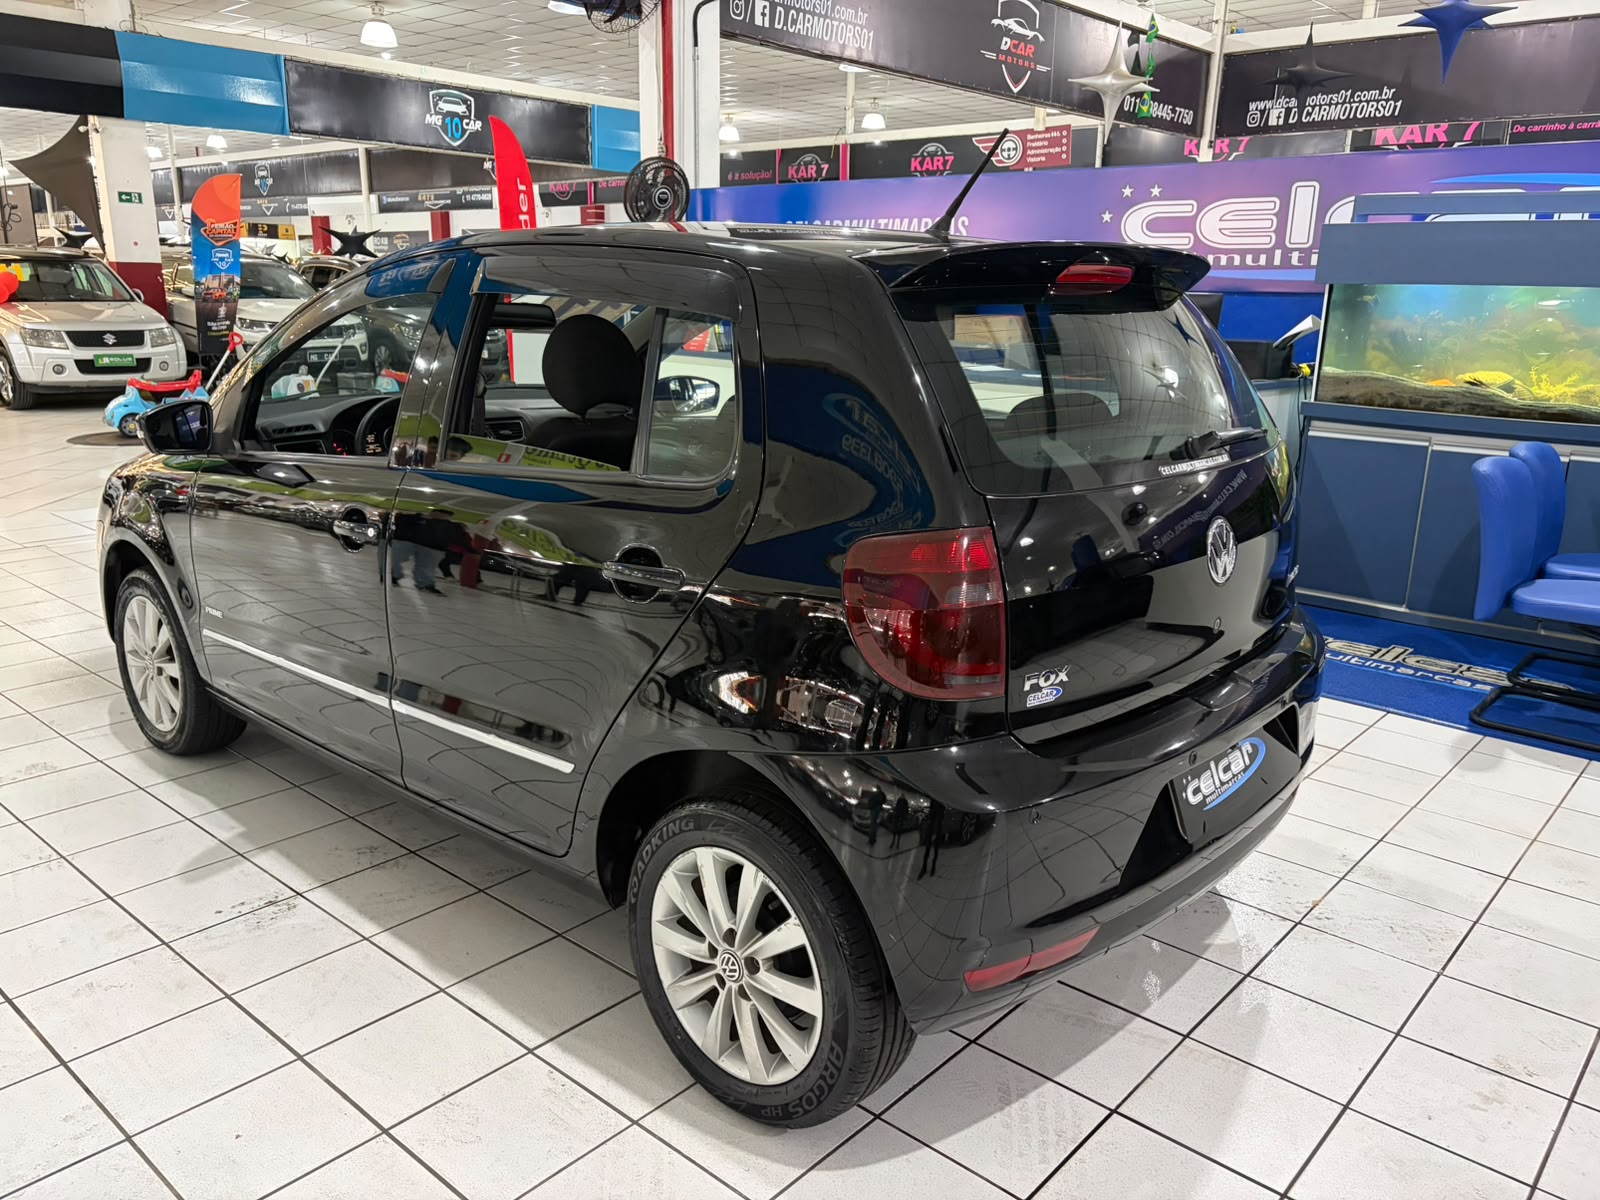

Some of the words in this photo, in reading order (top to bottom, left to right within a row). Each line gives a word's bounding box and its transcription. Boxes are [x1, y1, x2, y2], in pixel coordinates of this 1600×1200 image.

[774, 6, 874, 50] D.CARMOTORS01
[1000, 37, 1036, 58] DCAR
[998, 54, 1036, 70] MOTORS
[1150, 100, 1194, 125] 8445-7750
[425, 113, 443, 126] MG
[445, 116, 462, 139] 10
[462, 119, 482, 131] CAR
[1527, 122, 1567, 132] carrinho
[1184, 138, 1231, 156] KR
[788, 165, 817, 179] KAR
[820, 164, 829, 177] 7
[1023, 664, 1071, 691] FOX
[1028, 690, 1056, 702] CELCAR
[1187, 741, 1252, 805] celcar
[788, 1041, 844, 1118] ARGOS
